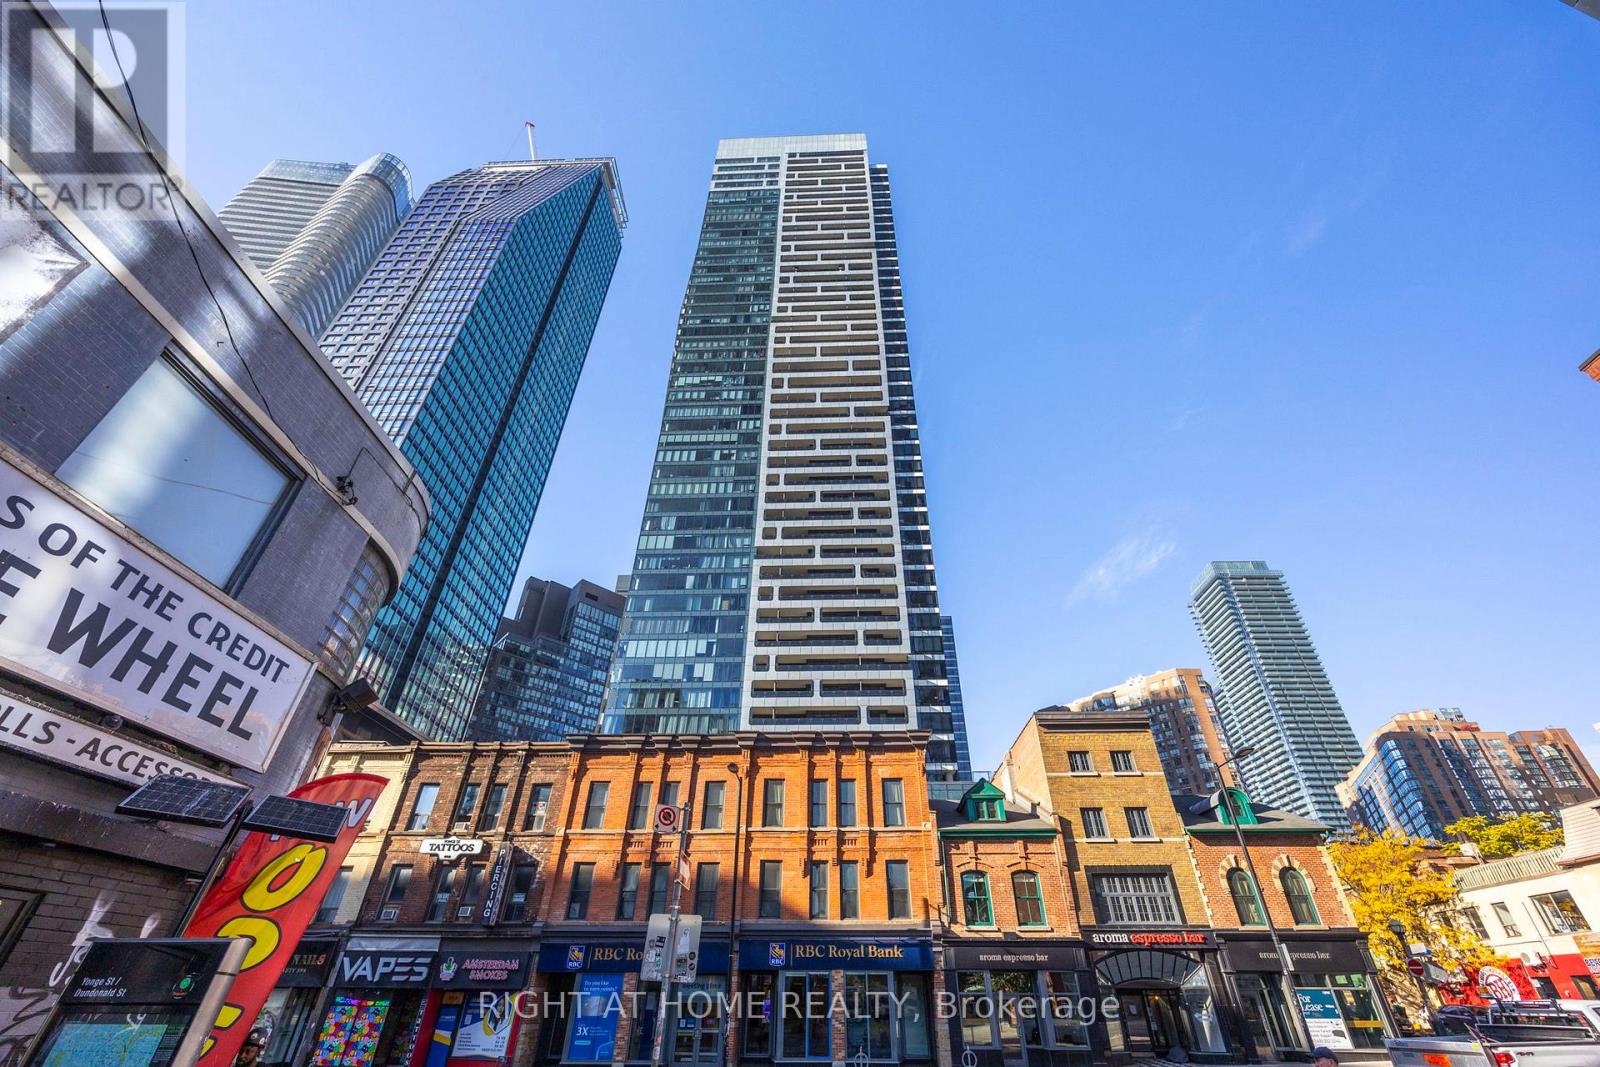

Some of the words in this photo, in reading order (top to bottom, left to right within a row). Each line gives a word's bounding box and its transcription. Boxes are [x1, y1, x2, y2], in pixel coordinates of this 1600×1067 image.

[0, 495, 35, 530] S
[38, 523, 106, 569] OF
[110, 558, 184, 622] THE
[187, 612, 290, 683] CREDIT
[46, 587, 259, 741] WHEEL
[0, 704, 61, 744] LLS
[429, 843, 475, 852] TATTOOS
[483, 848, 506, 917] PIERCING
[1092, 932, 1129, 944] aroma
[1130, 931, 1183, 948] espresso
[1184, 931, 1205, 943] bar
[594, 947, 624, 960] RBC
[795, 945, 826, 959] RBC
[828, 944, 865, 961] Royal
[868, 944, 903, 959] Bank
[979, 954, 1002, 962] aroma
[1003, 954, 1035, 963] espresso
[343, 956, 433, 982] VAPES
[462, 958, 520, 971] AMSTERDAM
[82, 977, 104, 987] Yonge
[105, 976, 115, 986] St
[468, 970, 509, 981] SMOKES
[74, 988, 116, 997] Dundonald
[116, 988, 127, 997] St
[576, 1026, 589, 1036] 3X
